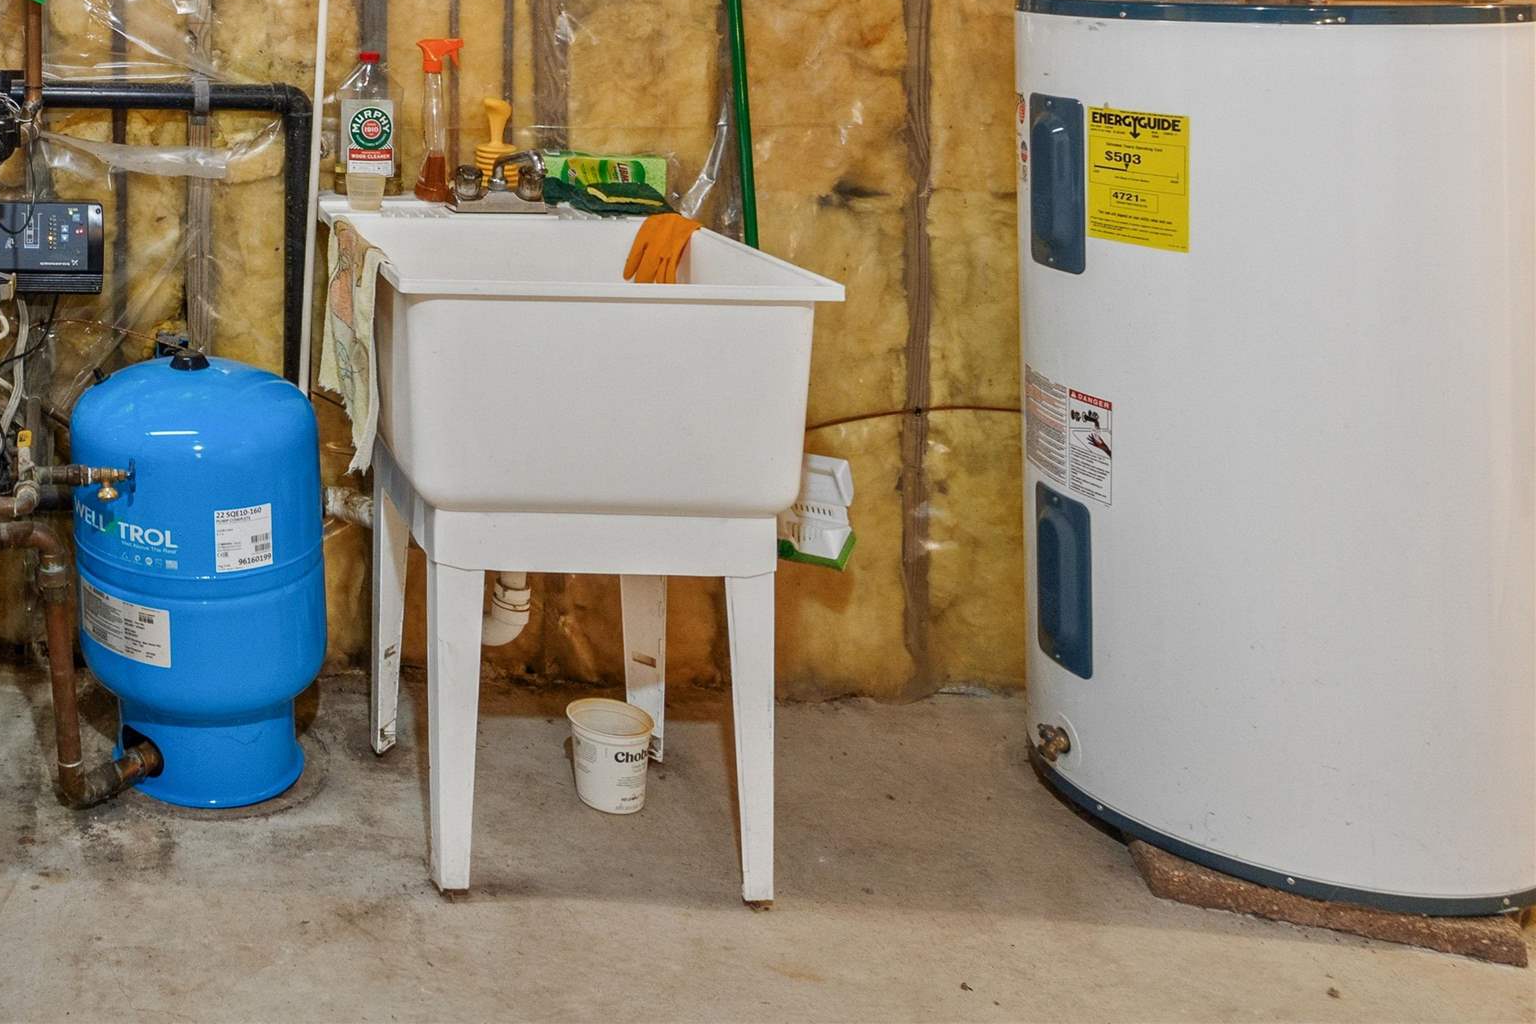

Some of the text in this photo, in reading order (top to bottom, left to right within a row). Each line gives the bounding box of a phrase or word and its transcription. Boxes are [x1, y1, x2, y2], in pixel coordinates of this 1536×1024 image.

[352, 110, 390, 133] MURPHY
[1091, 112, 1181, 132] ENERGYGUIDE
[1112, 192, 1139, 202] 4721
[1077, 392, 1110, 409] DANGER
[74, 496, 106, 532] WELL
[226, 507, 262, 517] SQE10-160
[118, 521, 178, 548] TROL
[238, 553, 272, 565] 96160199
